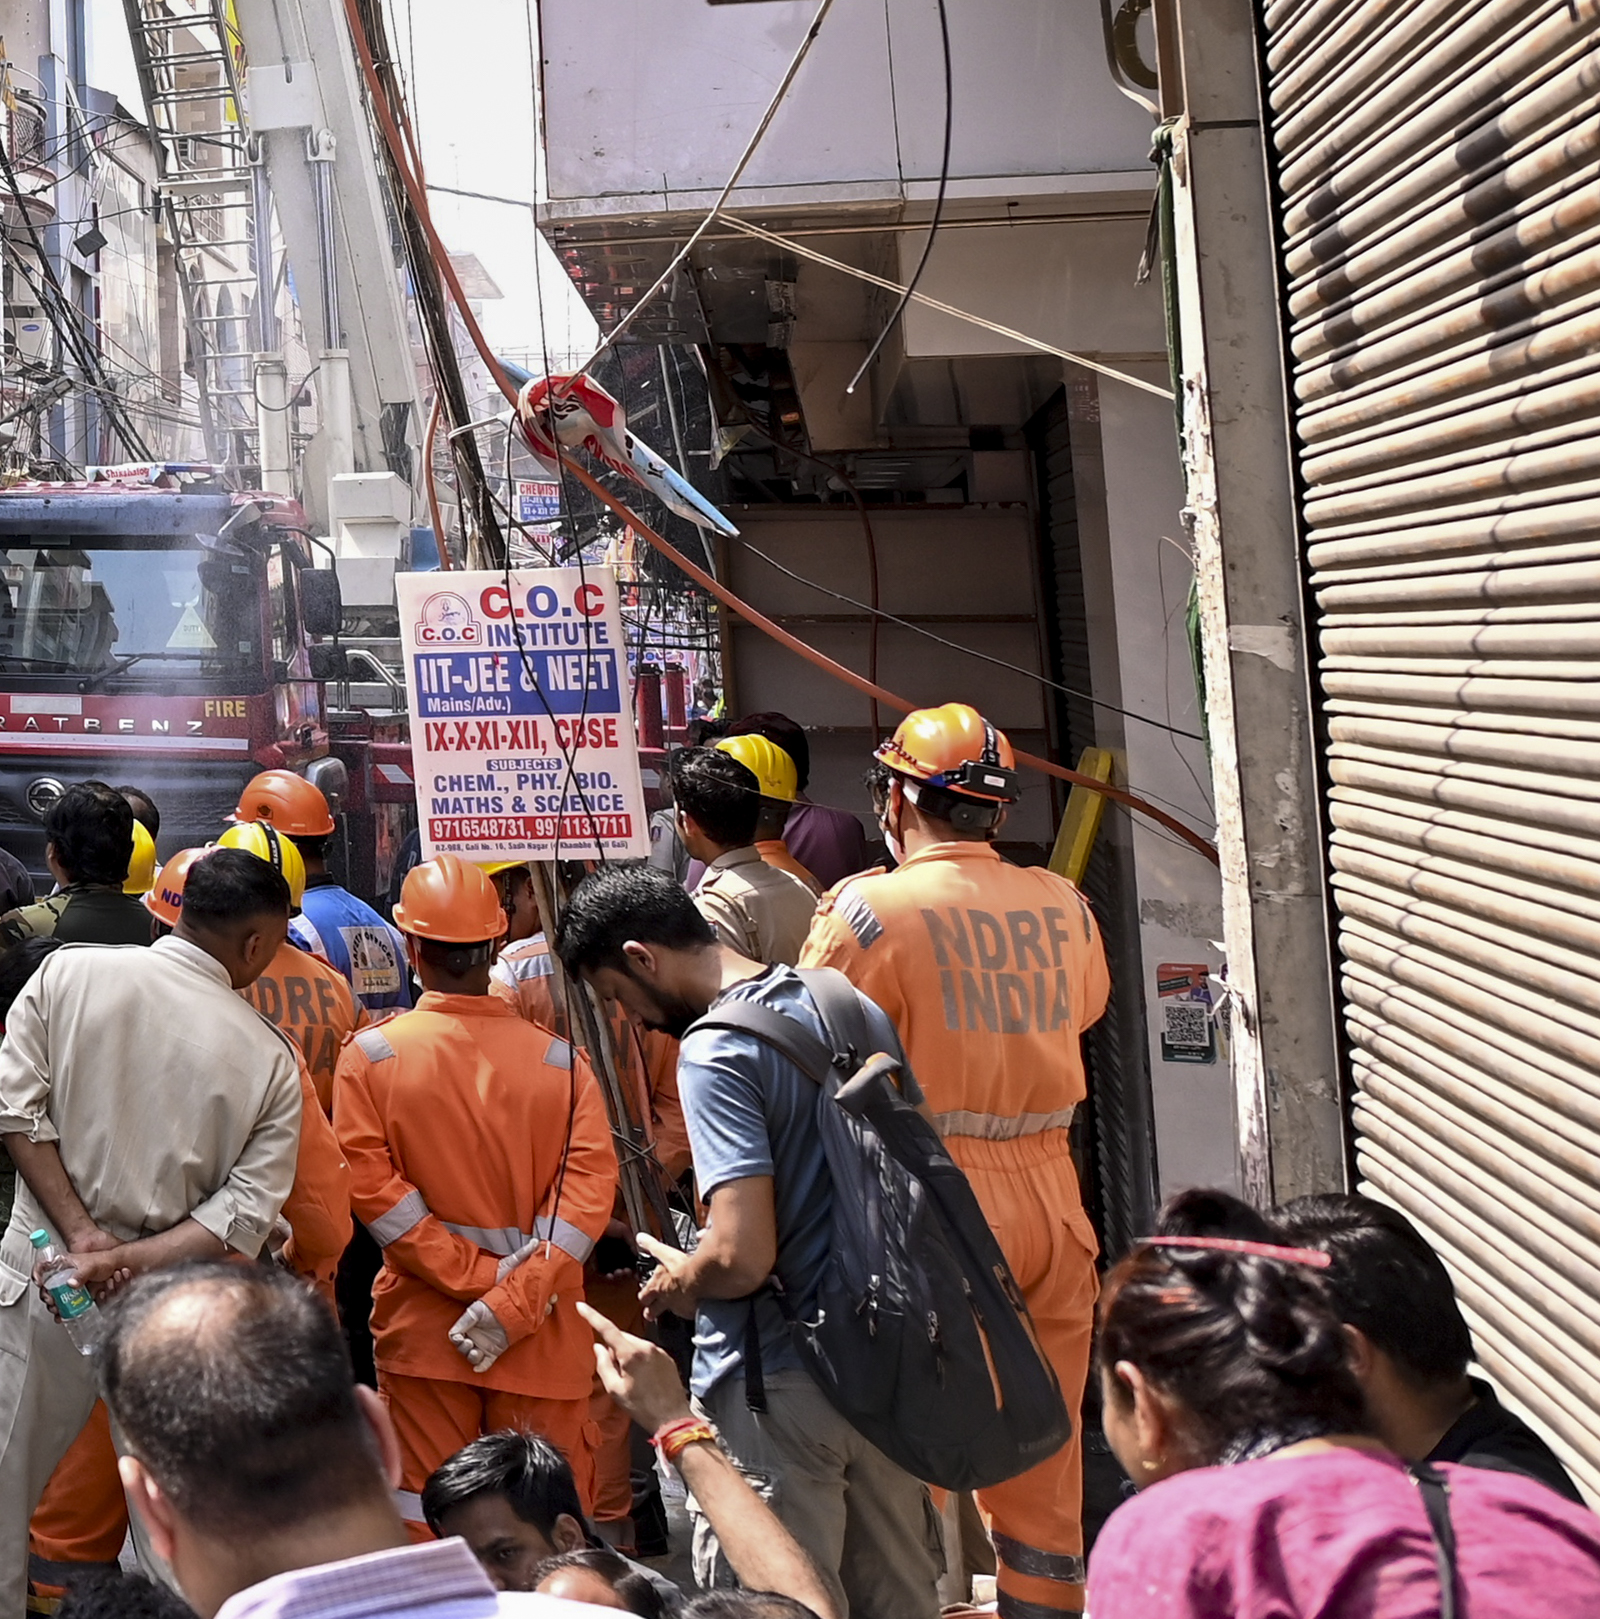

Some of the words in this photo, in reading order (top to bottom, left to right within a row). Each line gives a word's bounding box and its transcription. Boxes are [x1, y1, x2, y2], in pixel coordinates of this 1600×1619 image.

[480, 583, 605, 619] C.O.C
[422, 627, 476, 641] C.O.C
[487, 621, 609, 648] INSTITUTE
[419, 655, 512, 695] IIT-JEE
[519, 659, 538, 692] &
[546, 653, 611, 691] NEET
[204, 699, 246, 718] FIRE
[554, 718, 619, 749] CBSE
[489, 758, 560, 771] SUBJECTS
[433, 773, 510, 794] CHEM.,
[431, 795, 504, 815] MATHS
[511, 795, 527, 814] &
[534, 793, 625, 814] SCIENCE
[433, 818, 533, 840] 9716548731,
[921, 905, 1070, 971] NDRF
[938, 967, 1072, 1034] INDIA
